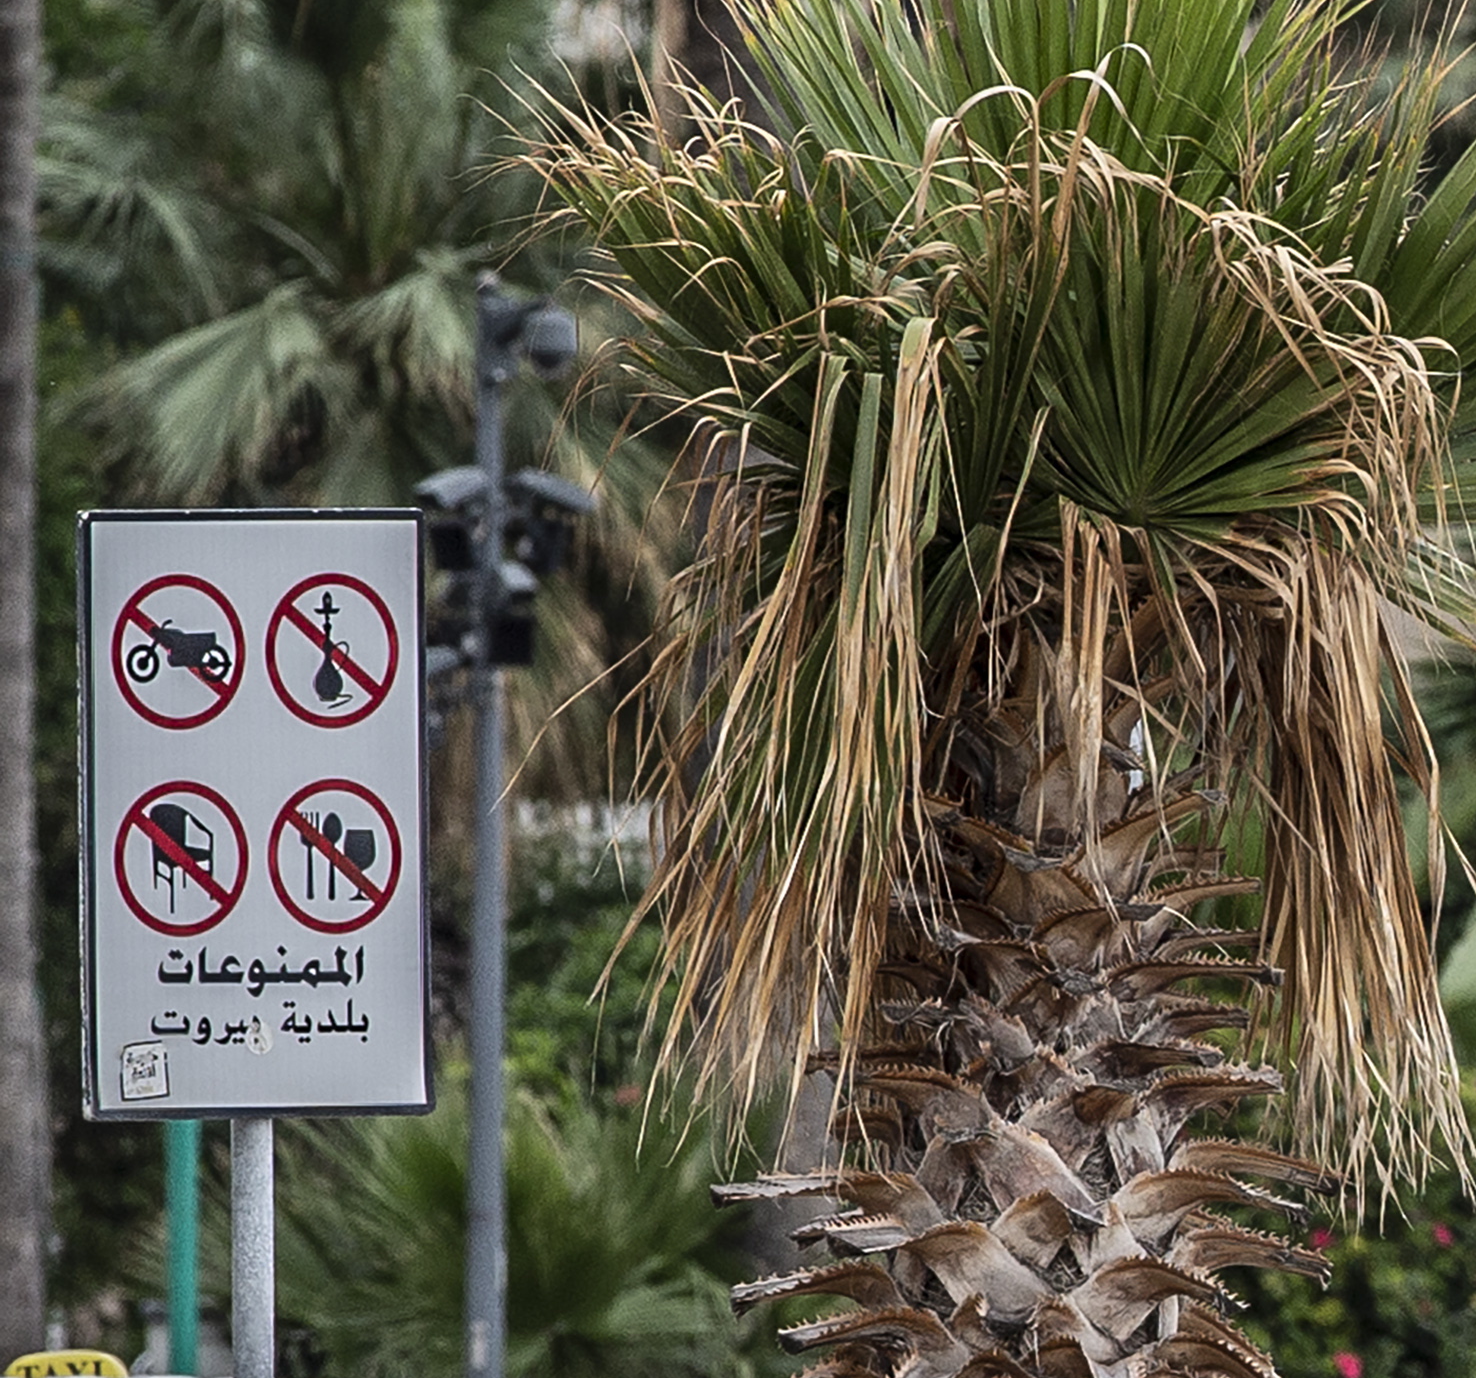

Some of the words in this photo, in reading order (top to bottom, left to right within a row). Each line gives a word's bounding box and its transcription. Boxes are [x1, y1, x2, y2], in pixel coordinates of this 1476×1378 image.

[157, 945, 365, 998] الممنوعات
[150, 1011, 262, 1045] بيروت
[280, 998, 370, 1044] بلدية
